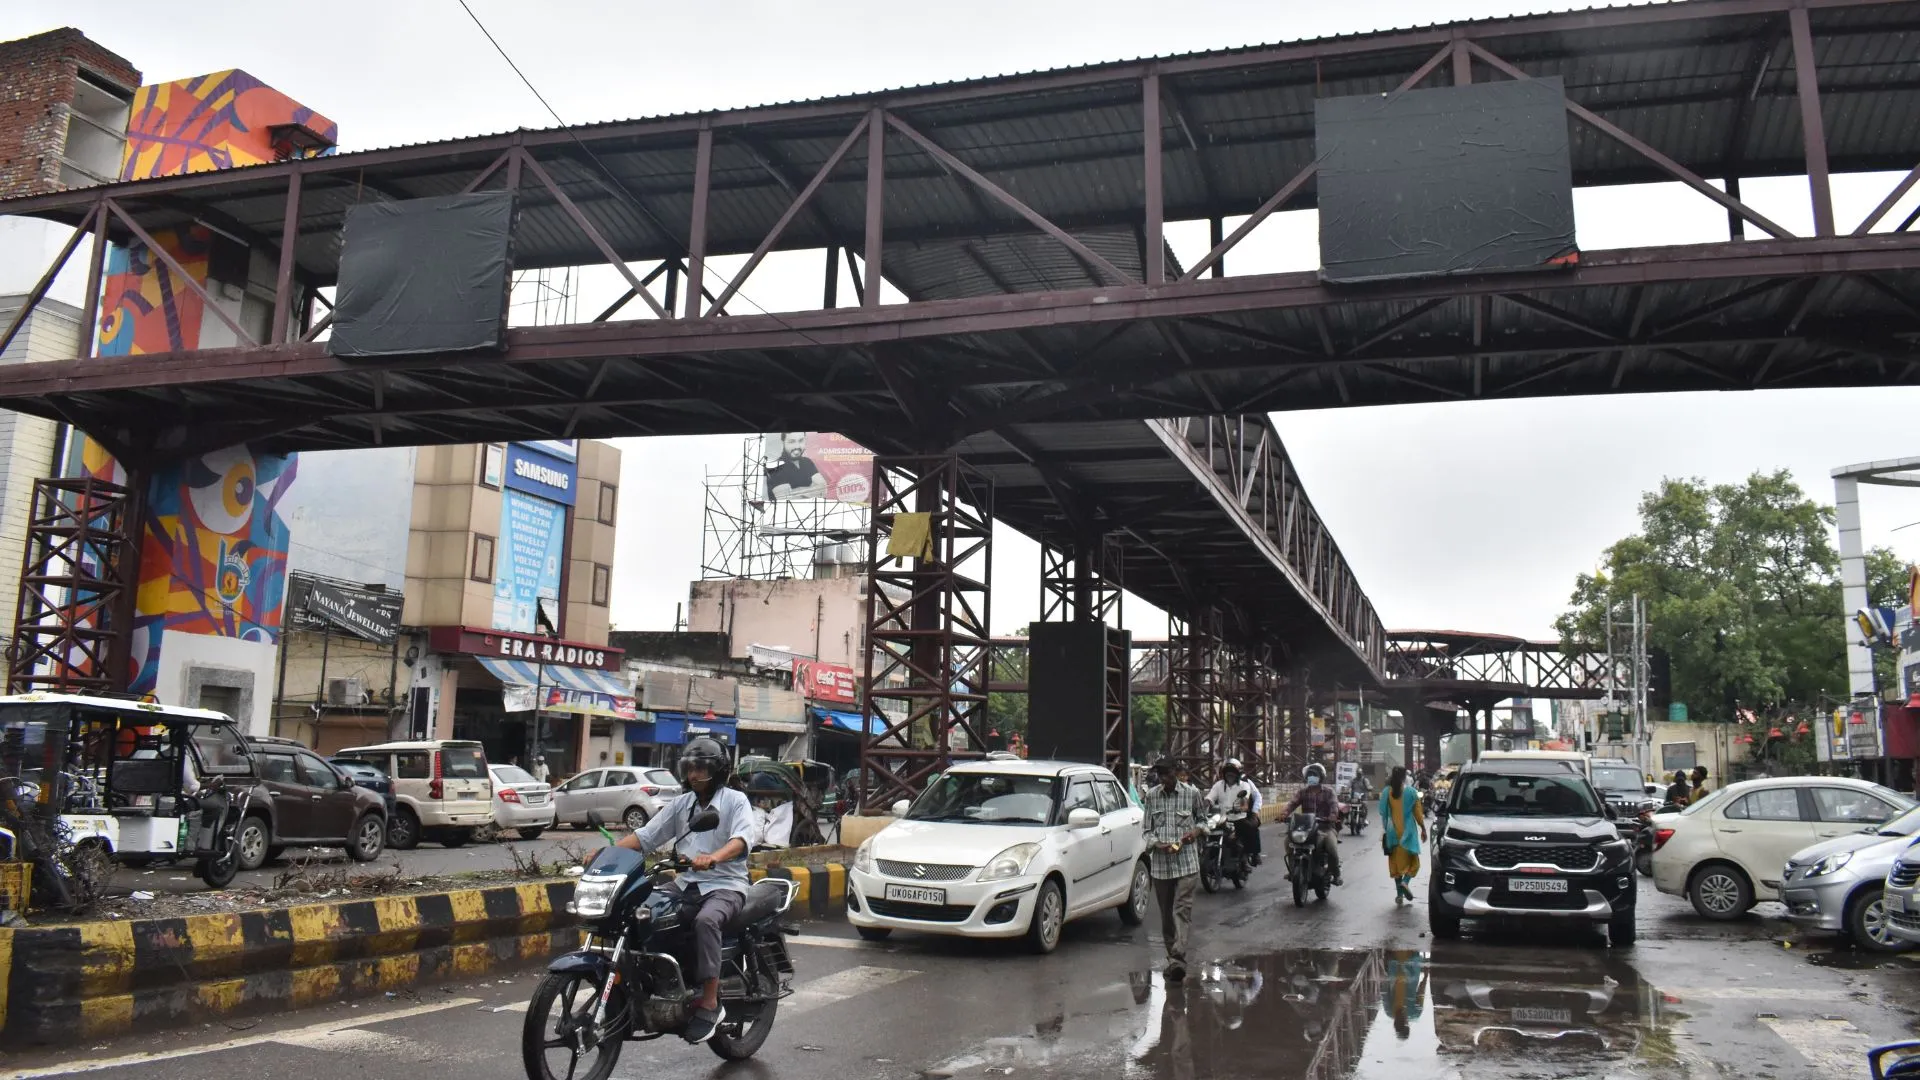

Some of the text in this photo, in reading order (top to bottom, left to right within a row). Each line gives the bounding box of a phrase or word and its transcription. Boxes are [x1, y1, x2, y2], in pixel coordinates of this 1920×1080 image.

[514, 458, 569, 490] SAMSUNG
[313, 590, 344, 614] NAYANA
[346, 608, 389, 637] JEWELLERS
[500, 638, 536, 658] ERA
[542, 643, 605, 666] RADIOS
[891, 888, 943, 902] UK06AF0150
[1514, 881, 1567, 891] UP25DU5494
